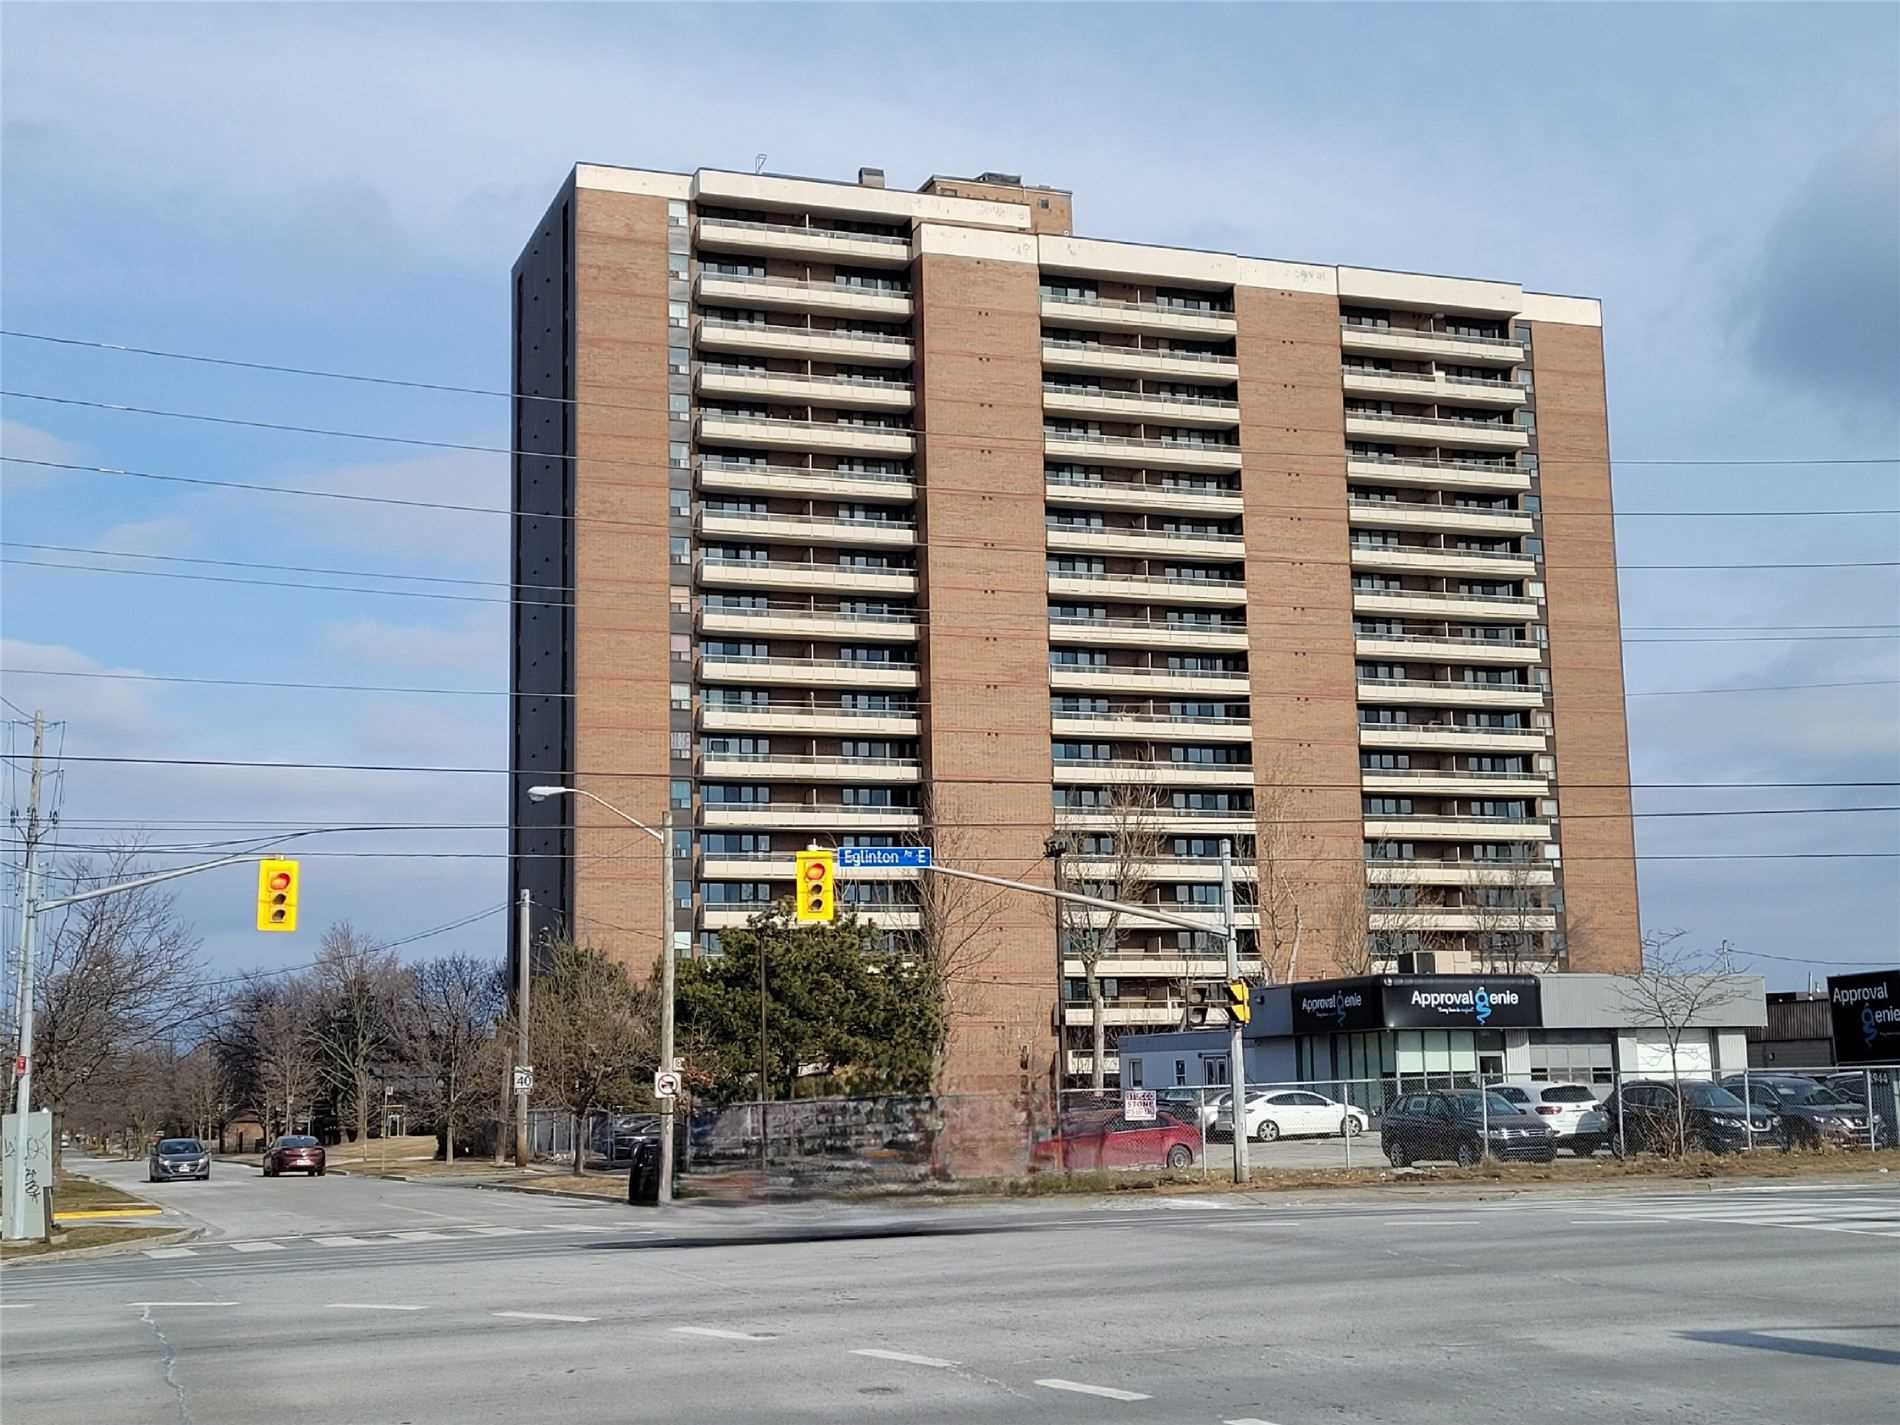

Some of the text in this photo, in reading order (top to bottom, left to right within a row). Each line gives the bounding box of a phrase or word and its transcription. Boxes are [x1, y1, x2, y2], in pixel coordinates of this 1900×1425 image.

[844, 849, 899, 866] Eglinton
[918, 849, 926, 863] E
[1411, 989, 1474, 1008] Approval
[1833, 981, 1889, 1007] Approval
[1302, 994, 1336, 1014] Approval
[516, 1073, 531, 1087] 40
